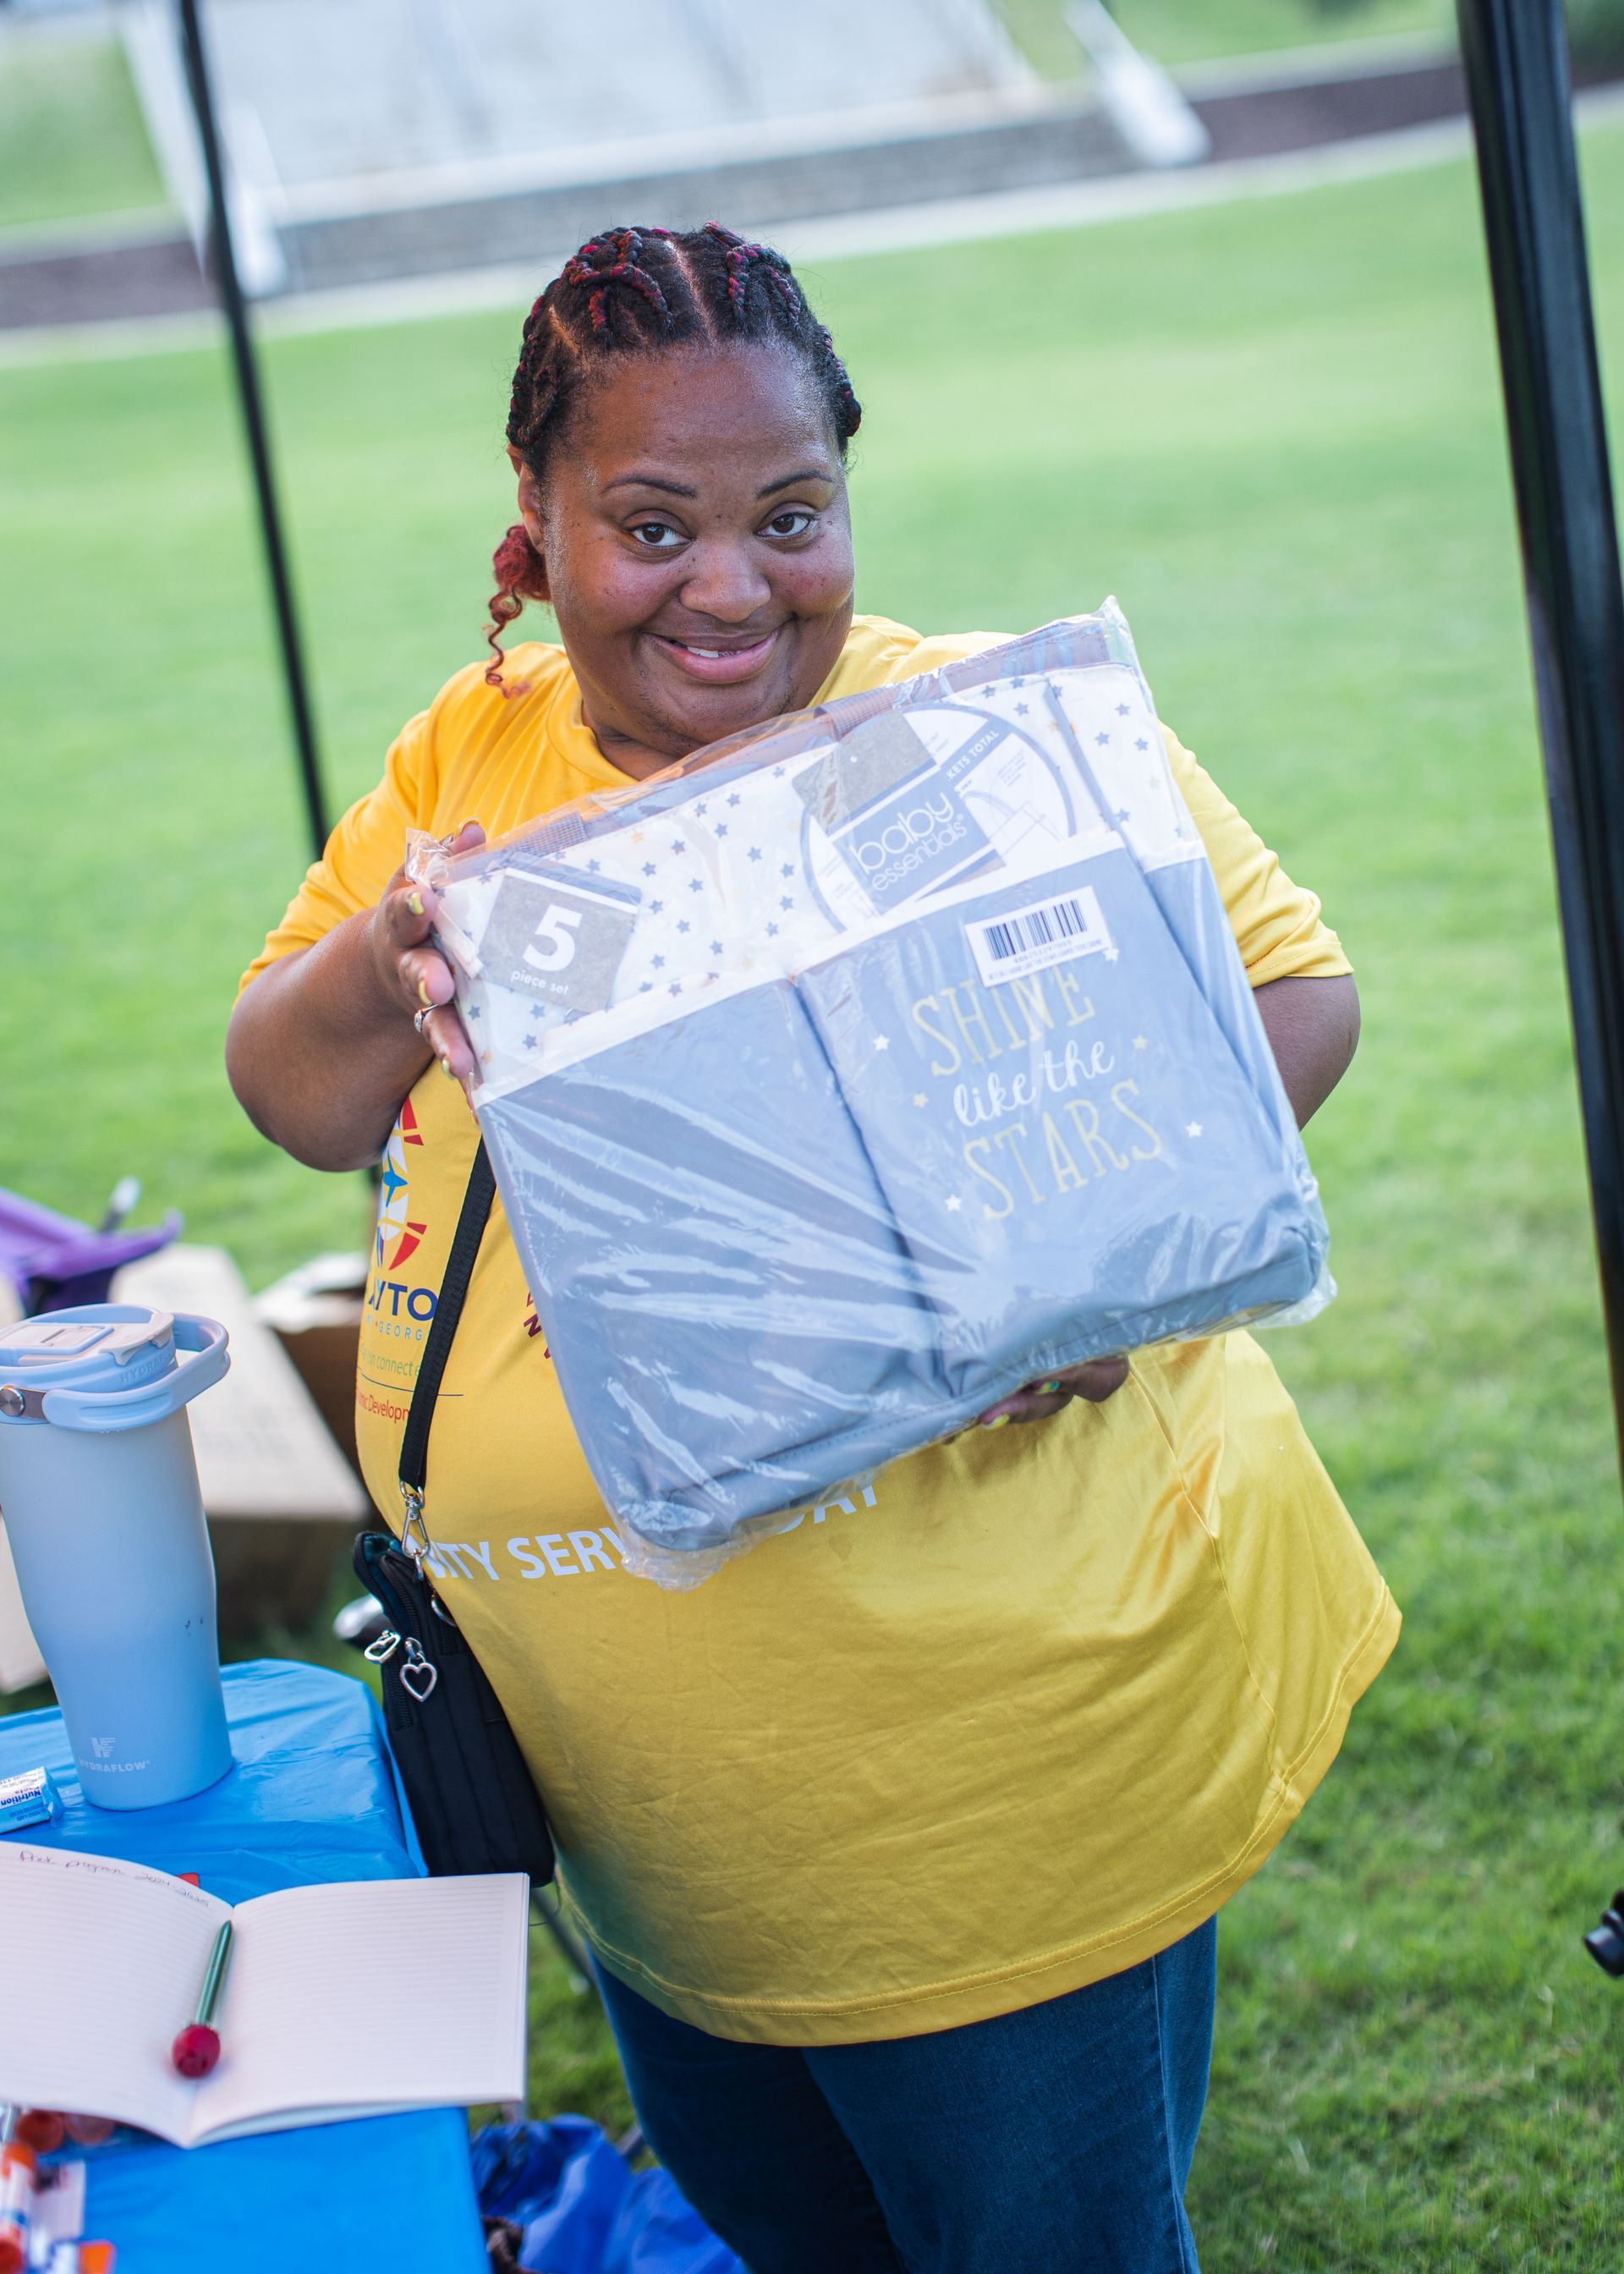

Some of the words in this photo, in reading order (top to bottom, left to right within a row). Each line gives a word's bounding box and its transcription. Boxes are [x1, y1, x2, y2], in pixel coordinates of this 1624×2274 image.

[945, 755, 969, 781] KETS
[968, 729, 1000, 758] TOTAL
[849, 792, 955, 874] baby
[872, 820, 968, 891] essentials
[523, 904, 583, 971] 5
[510, 969, 546, 989] piece
[549, 982, 569, 996] set
[911, 962, 1096, 1077] SHINE
[953, 1072, 1037, 1128] like
[1038, 1040, 1116, 1093] the
[963, 1078, 1162, 1220] STARS
[378, 1320, 423, 1341] GEORG
[376, 1355, 414, 1377] connect
[0, 1789, 41, 1806] Nutrition
